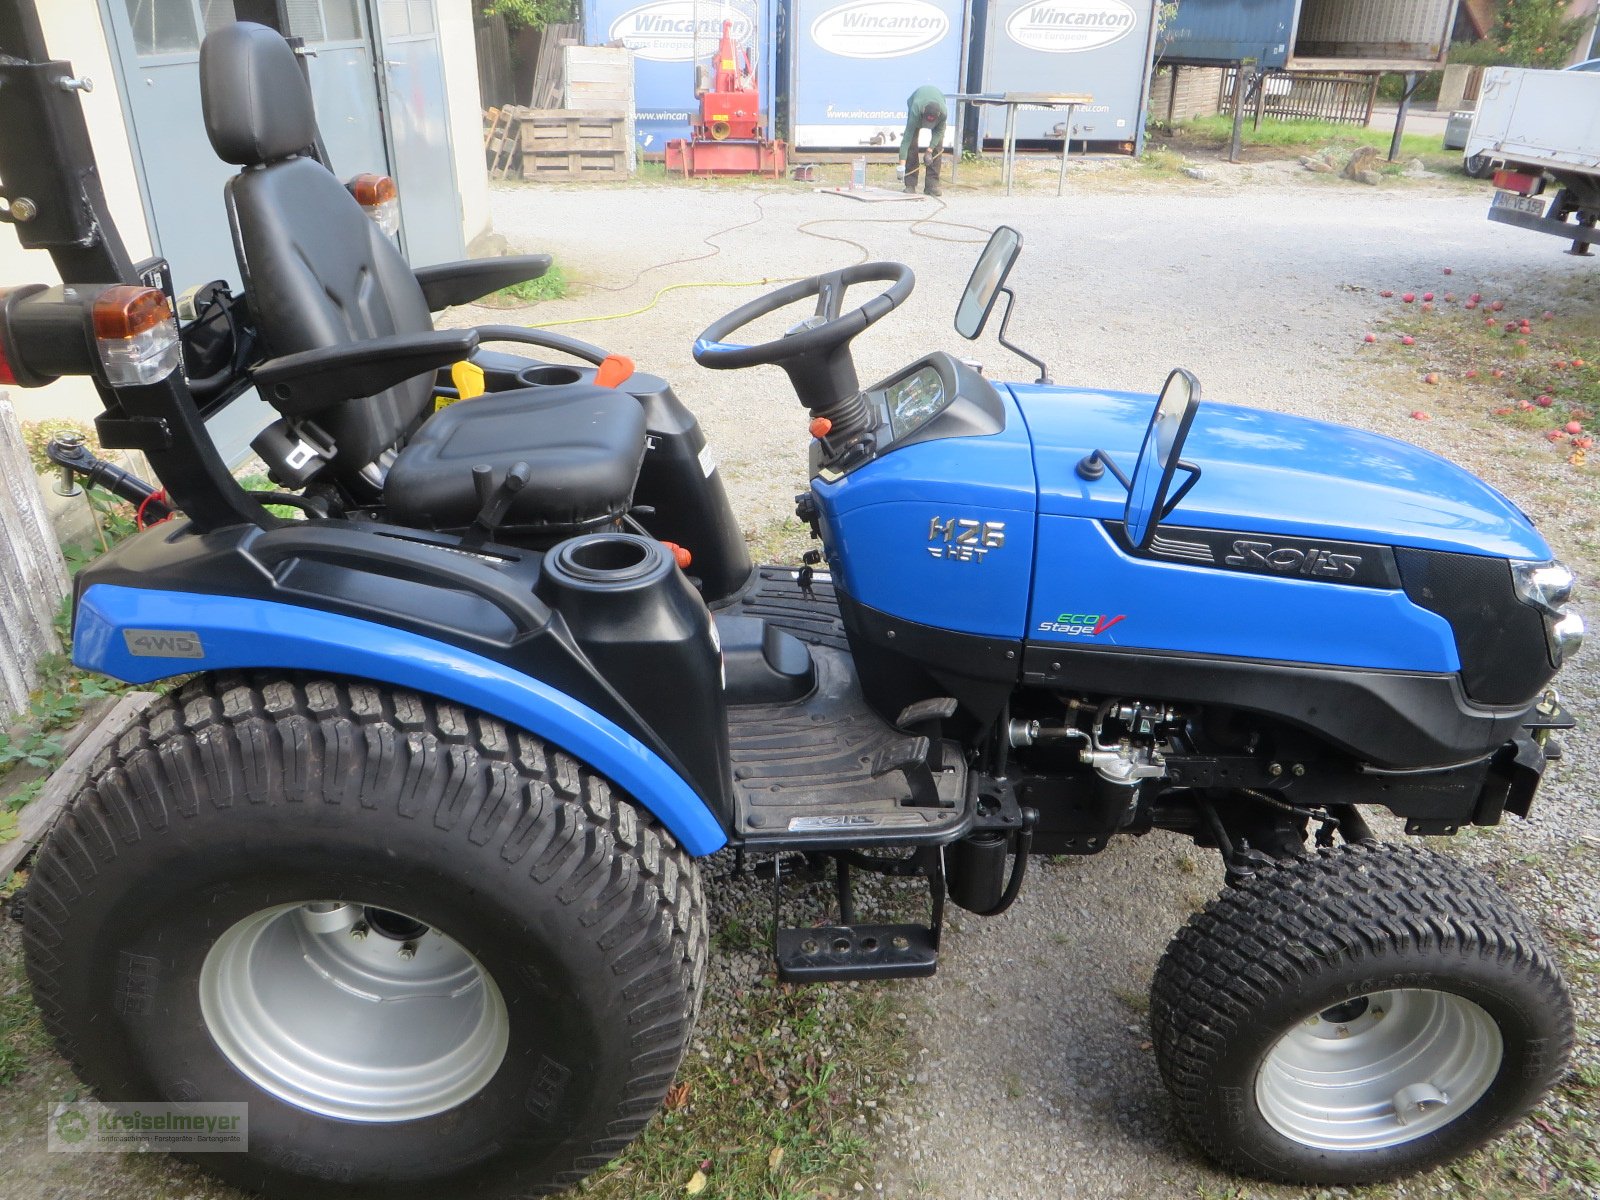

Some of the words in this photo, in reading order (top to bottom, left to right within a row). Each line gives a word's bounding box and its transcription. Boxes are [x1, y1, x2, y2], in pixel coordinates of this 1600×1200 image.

[634, 14, 746, 34] Wincantn
[842, 12, 942, 29] Wincanton
[1030, 8, 1130, 27] Wincanton
[1018, 31, 1042, 40] Trans
[1044, 31, 1088, 42] European
[1017, 103, 1110, 114] www.wincantn.eu.com
[928, 515, 1006, 547] H26
[946, 544, 989, 564] HST
[1038, 622, 1095, 636] Stage
[1093, 614, 1127, 635] V
[1057, 613, 1100, 625] ECO
[134, 636, 194, 652] 4WD
